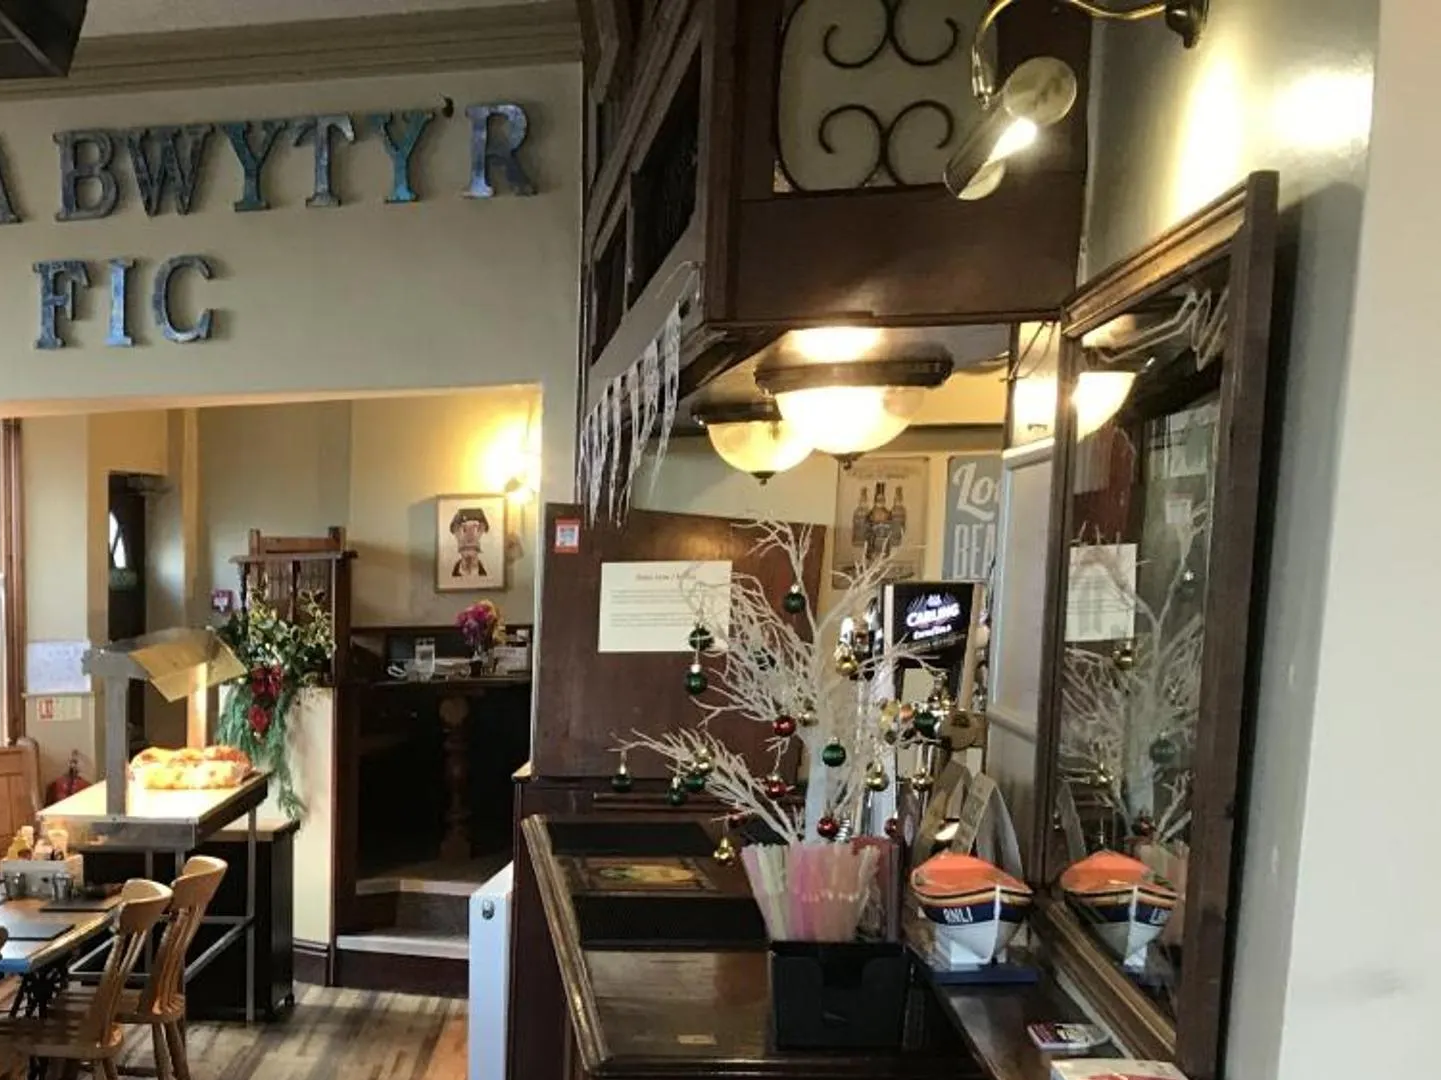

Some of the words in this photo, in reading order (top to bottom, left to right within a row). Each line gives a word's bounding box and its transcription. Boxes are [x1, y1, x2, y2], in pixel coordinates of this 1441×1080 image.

[32, 254, 221, 351] FIC
[906, 602, 960, 628] CARLING
[943, 906, 973, 922] RNLI
